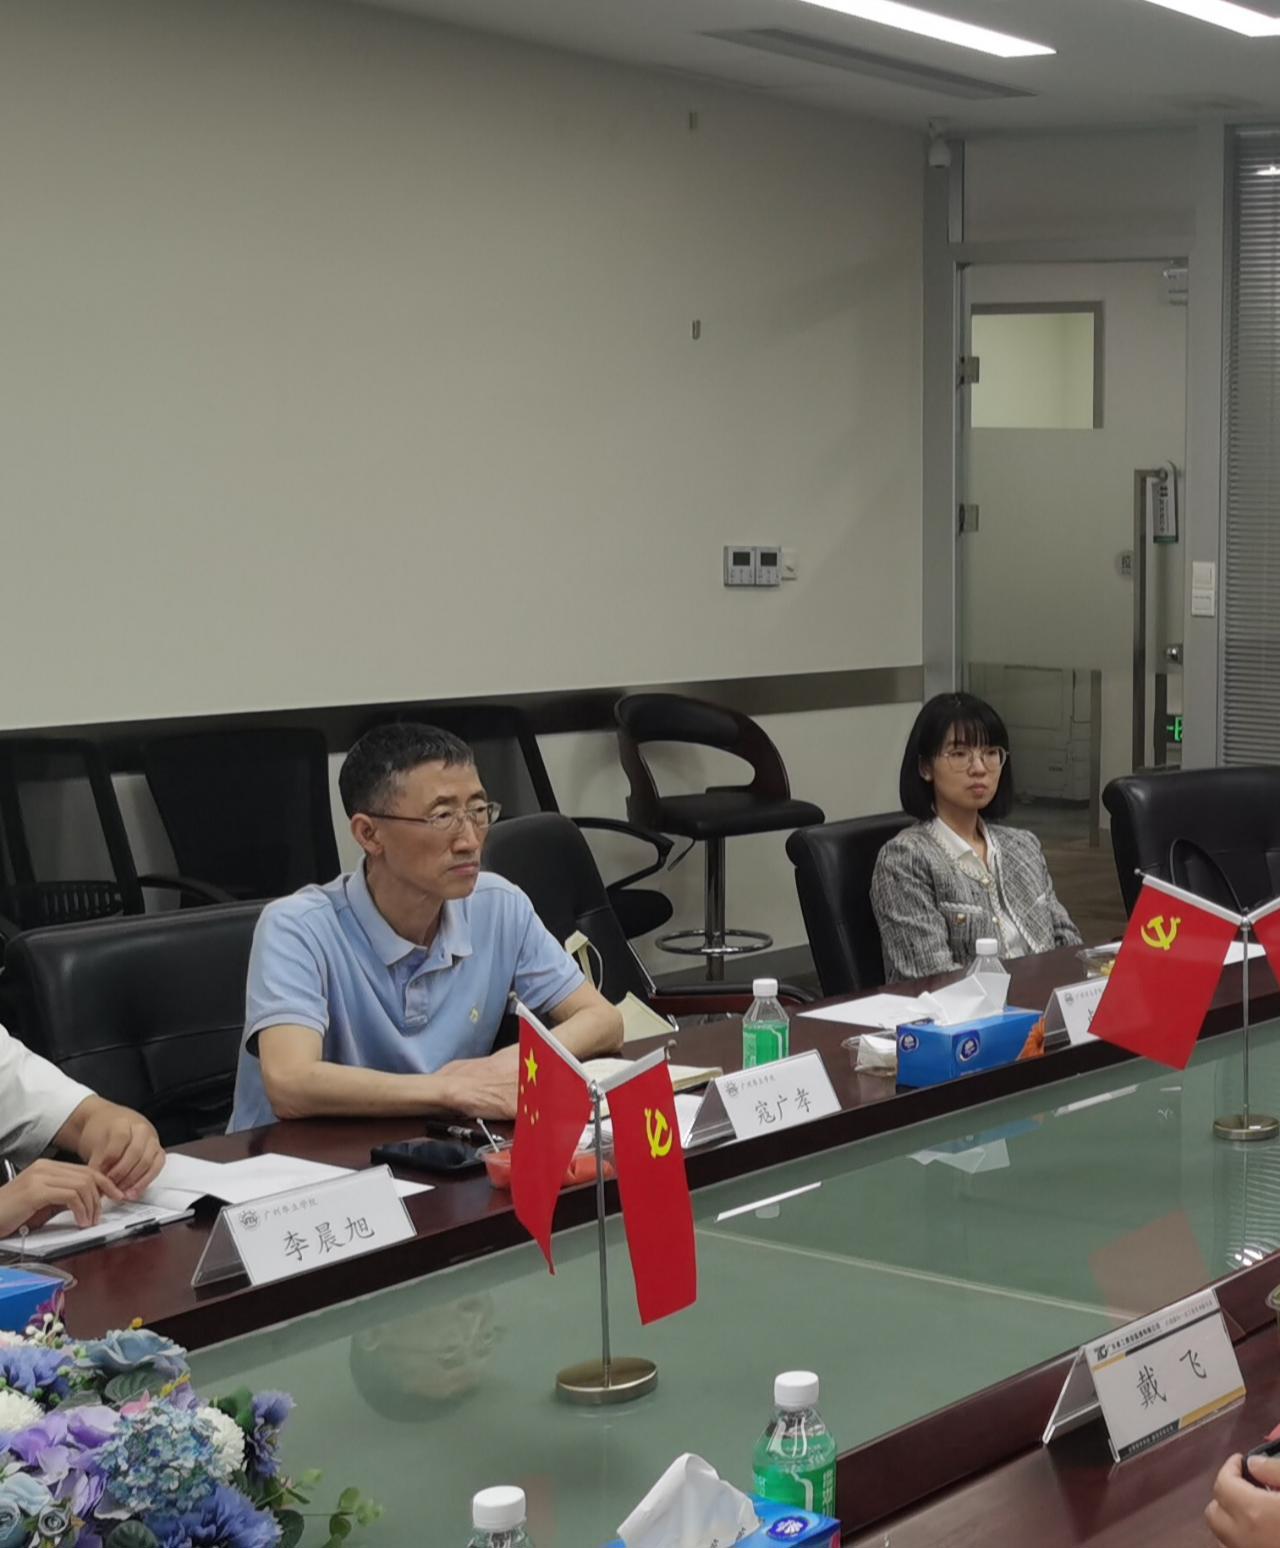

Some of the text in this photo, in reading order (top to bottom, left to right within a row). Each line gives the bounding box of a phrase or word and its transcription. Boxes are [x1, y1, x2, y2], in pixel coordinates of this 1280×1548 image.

[754, 1087, 813, 1125] 寇广孝
[283, 1215, 376, 1262] 李晨旭
